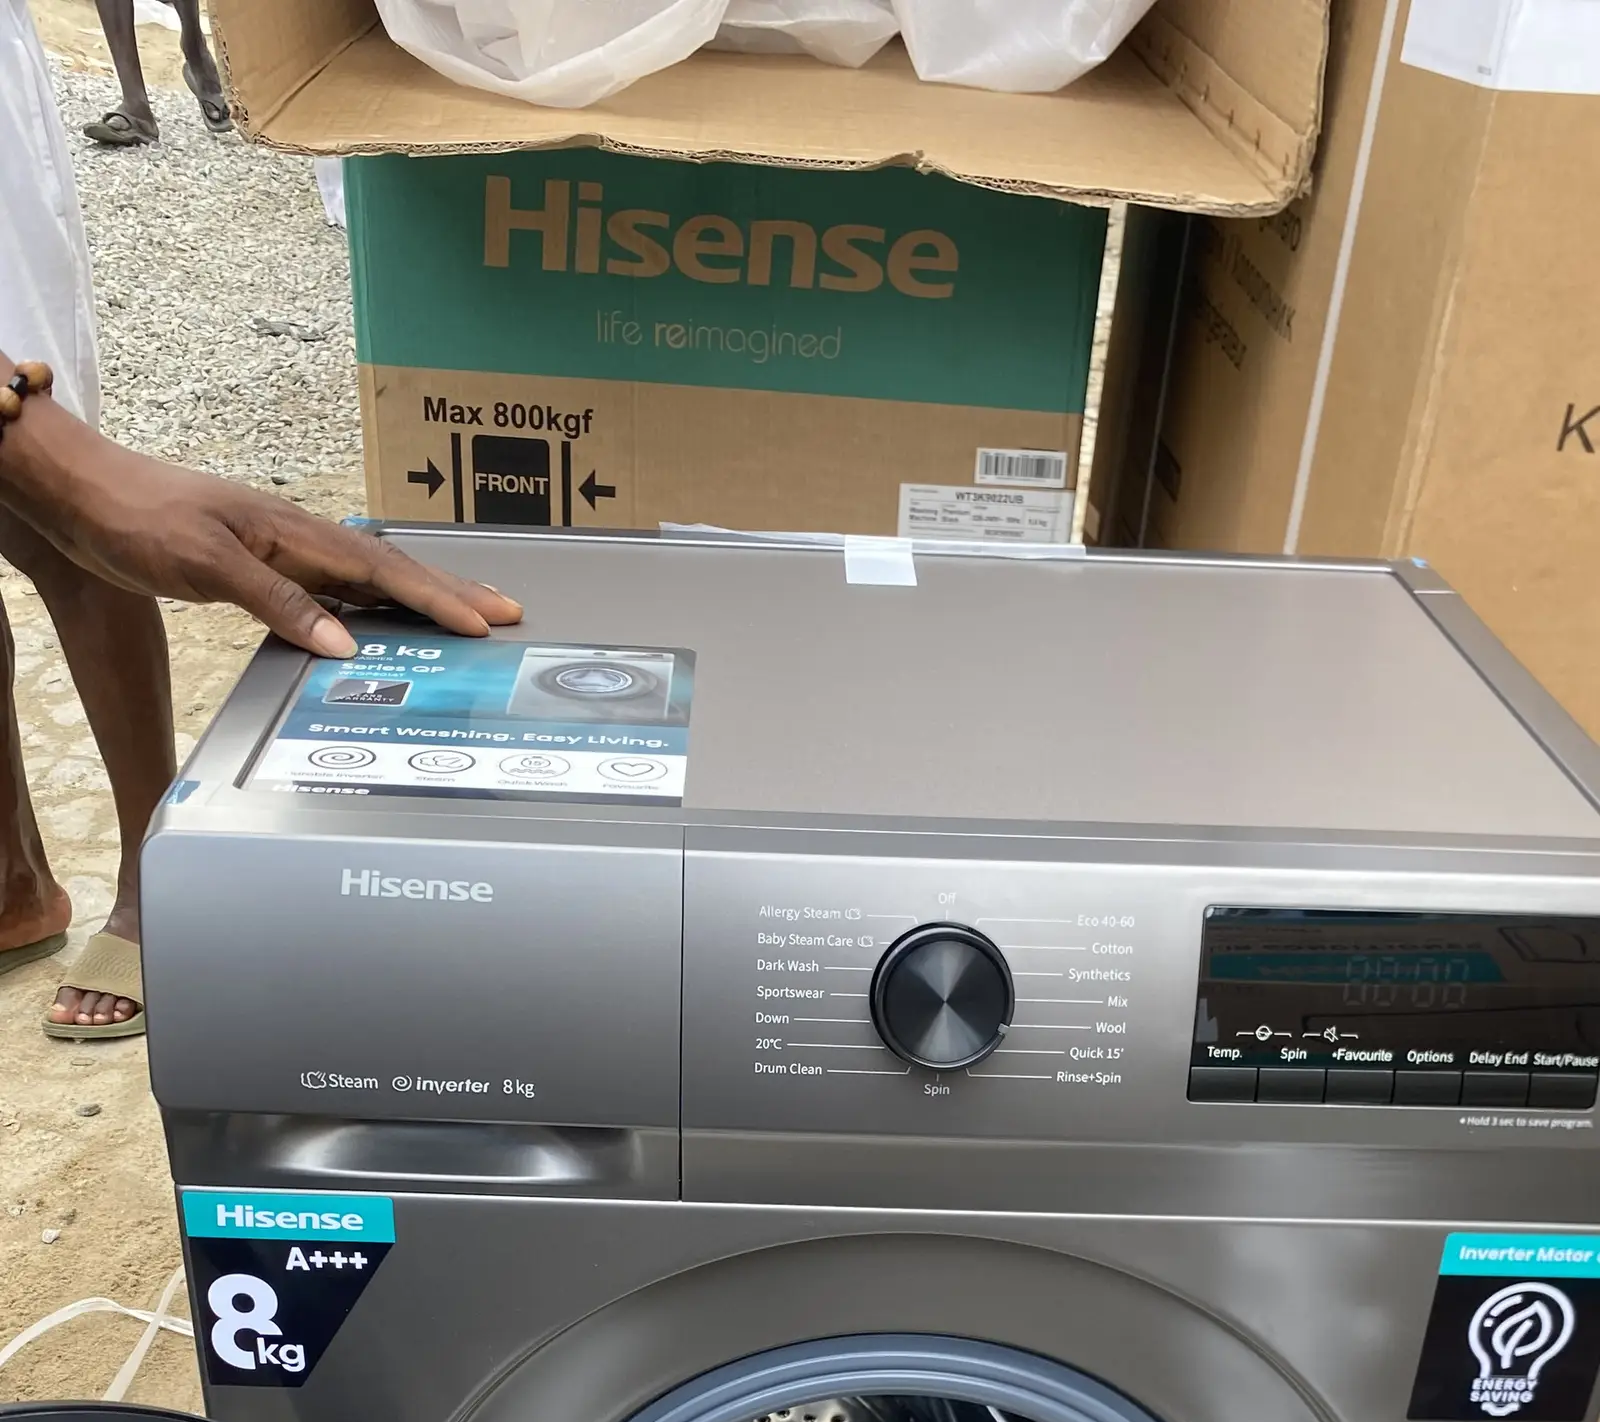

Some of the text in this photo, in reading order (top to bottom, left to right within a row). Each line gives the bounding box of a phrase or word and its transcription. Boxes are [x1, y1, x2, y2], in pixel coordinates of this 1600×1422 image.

[482, 175, 960, 298] Hisense
[597, 309, 843, 364] life reimagined
[423, 397, 594, 440] Max 800kgf
[474, 471, 549, 496] FRONT
[361, 644, 442, 660] 8 kg
[341, 663, 446, 674] Series QP
[308, 722, 669, 748] Smart Washing. Easy Living.
[272, 784, 371, 796] Hisense
[340, 868, 494, 903] Hisense
[937, 892, 957, 905] Off
[759, 905, 841, 921] Allergy Steam
[1077, 914, 1135, 928] Eco 40-60
[757, 933, 854, 949] Baby Steam Care
[1091, 942, 1133, 956] Cotton
[756, 958, 820, 973] Dark Wash
[1068, 967, 1131, 984] Synthetics
[756, 985, 825, 1001] Sportswear
[1107, 994, 1129, 1008] Mix
[755, 1011, 790, 1025] Down
[1095, 1021, 1126, 1035] Wool
[1069, 1046, 1104, 1061] Quick
[1206, 1045, 1243, 1061] Temp.
[1280, 1047, 1308, 1062] Spin
[1406, 1050, 1454, 1065] Options
[1469, 1051, 1528, 1067] Delay End
[1533, 1053, 1599, 1068] Start/Pause
[754, 1062, 823, 1076] Drum Clean
[328, 1073, 535, 1099] Steam inverter 8 kg
[1056, 1071, 1122, 1086] Rinse+Spin
[923, 1082, 950, 1097] Spin
[1467, 1116, 1490, 1127] Hold
[1516, 1117, 1526, 1127] to
[1528, 1119, 1549, 1128] save
[215, 1203, 364, 1231] Hisense
[285, 1246, 368, 1272] A+++
[1459, 1245, 1535, 1262] Inverter
[1536, 1246, 1593, 1262] Motor
[1472, 1377, 1538, 1391] ENERGY
[1470, 1390, 1534, 1403] SAVING
